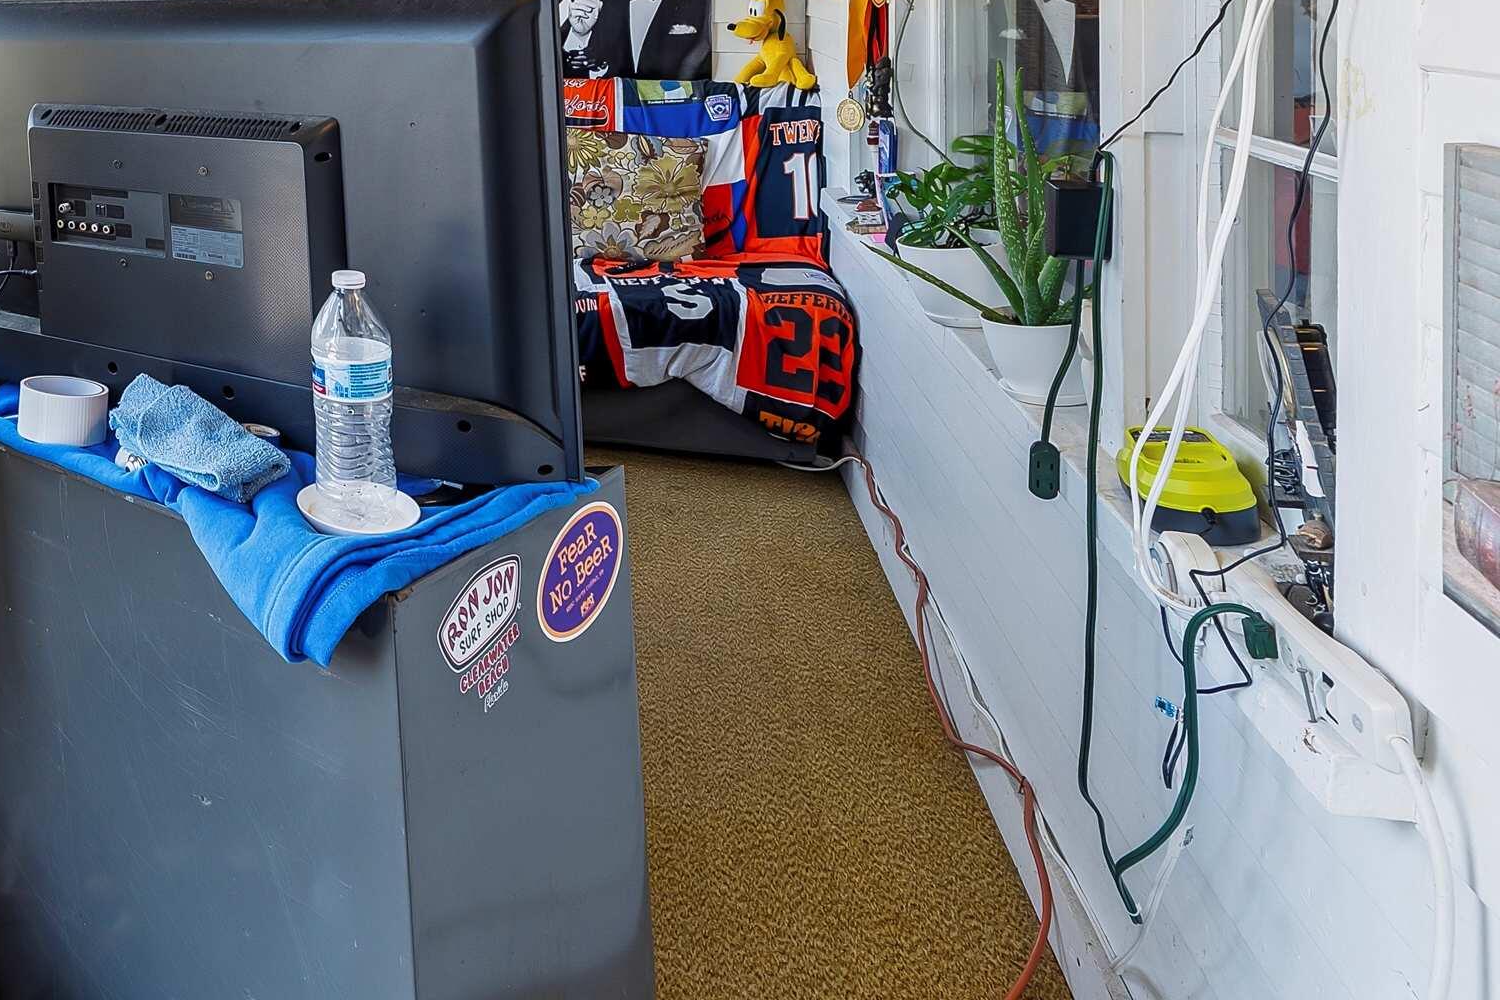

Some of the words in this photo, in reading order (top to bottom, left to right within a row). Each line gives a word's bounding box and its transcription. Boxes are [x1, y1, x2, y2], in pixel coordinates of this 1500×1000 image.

[448, 587, 479, 650] RON
[483, 566, 515, 605] JON
[459, 622, 482, 655] SURF
[485, 596, 509, 629] SHOP
[549, 579, 572, 615] NO
[460, 623, 520, 694] CLEARWATER
[477, 655, 509, 698] BEACH
